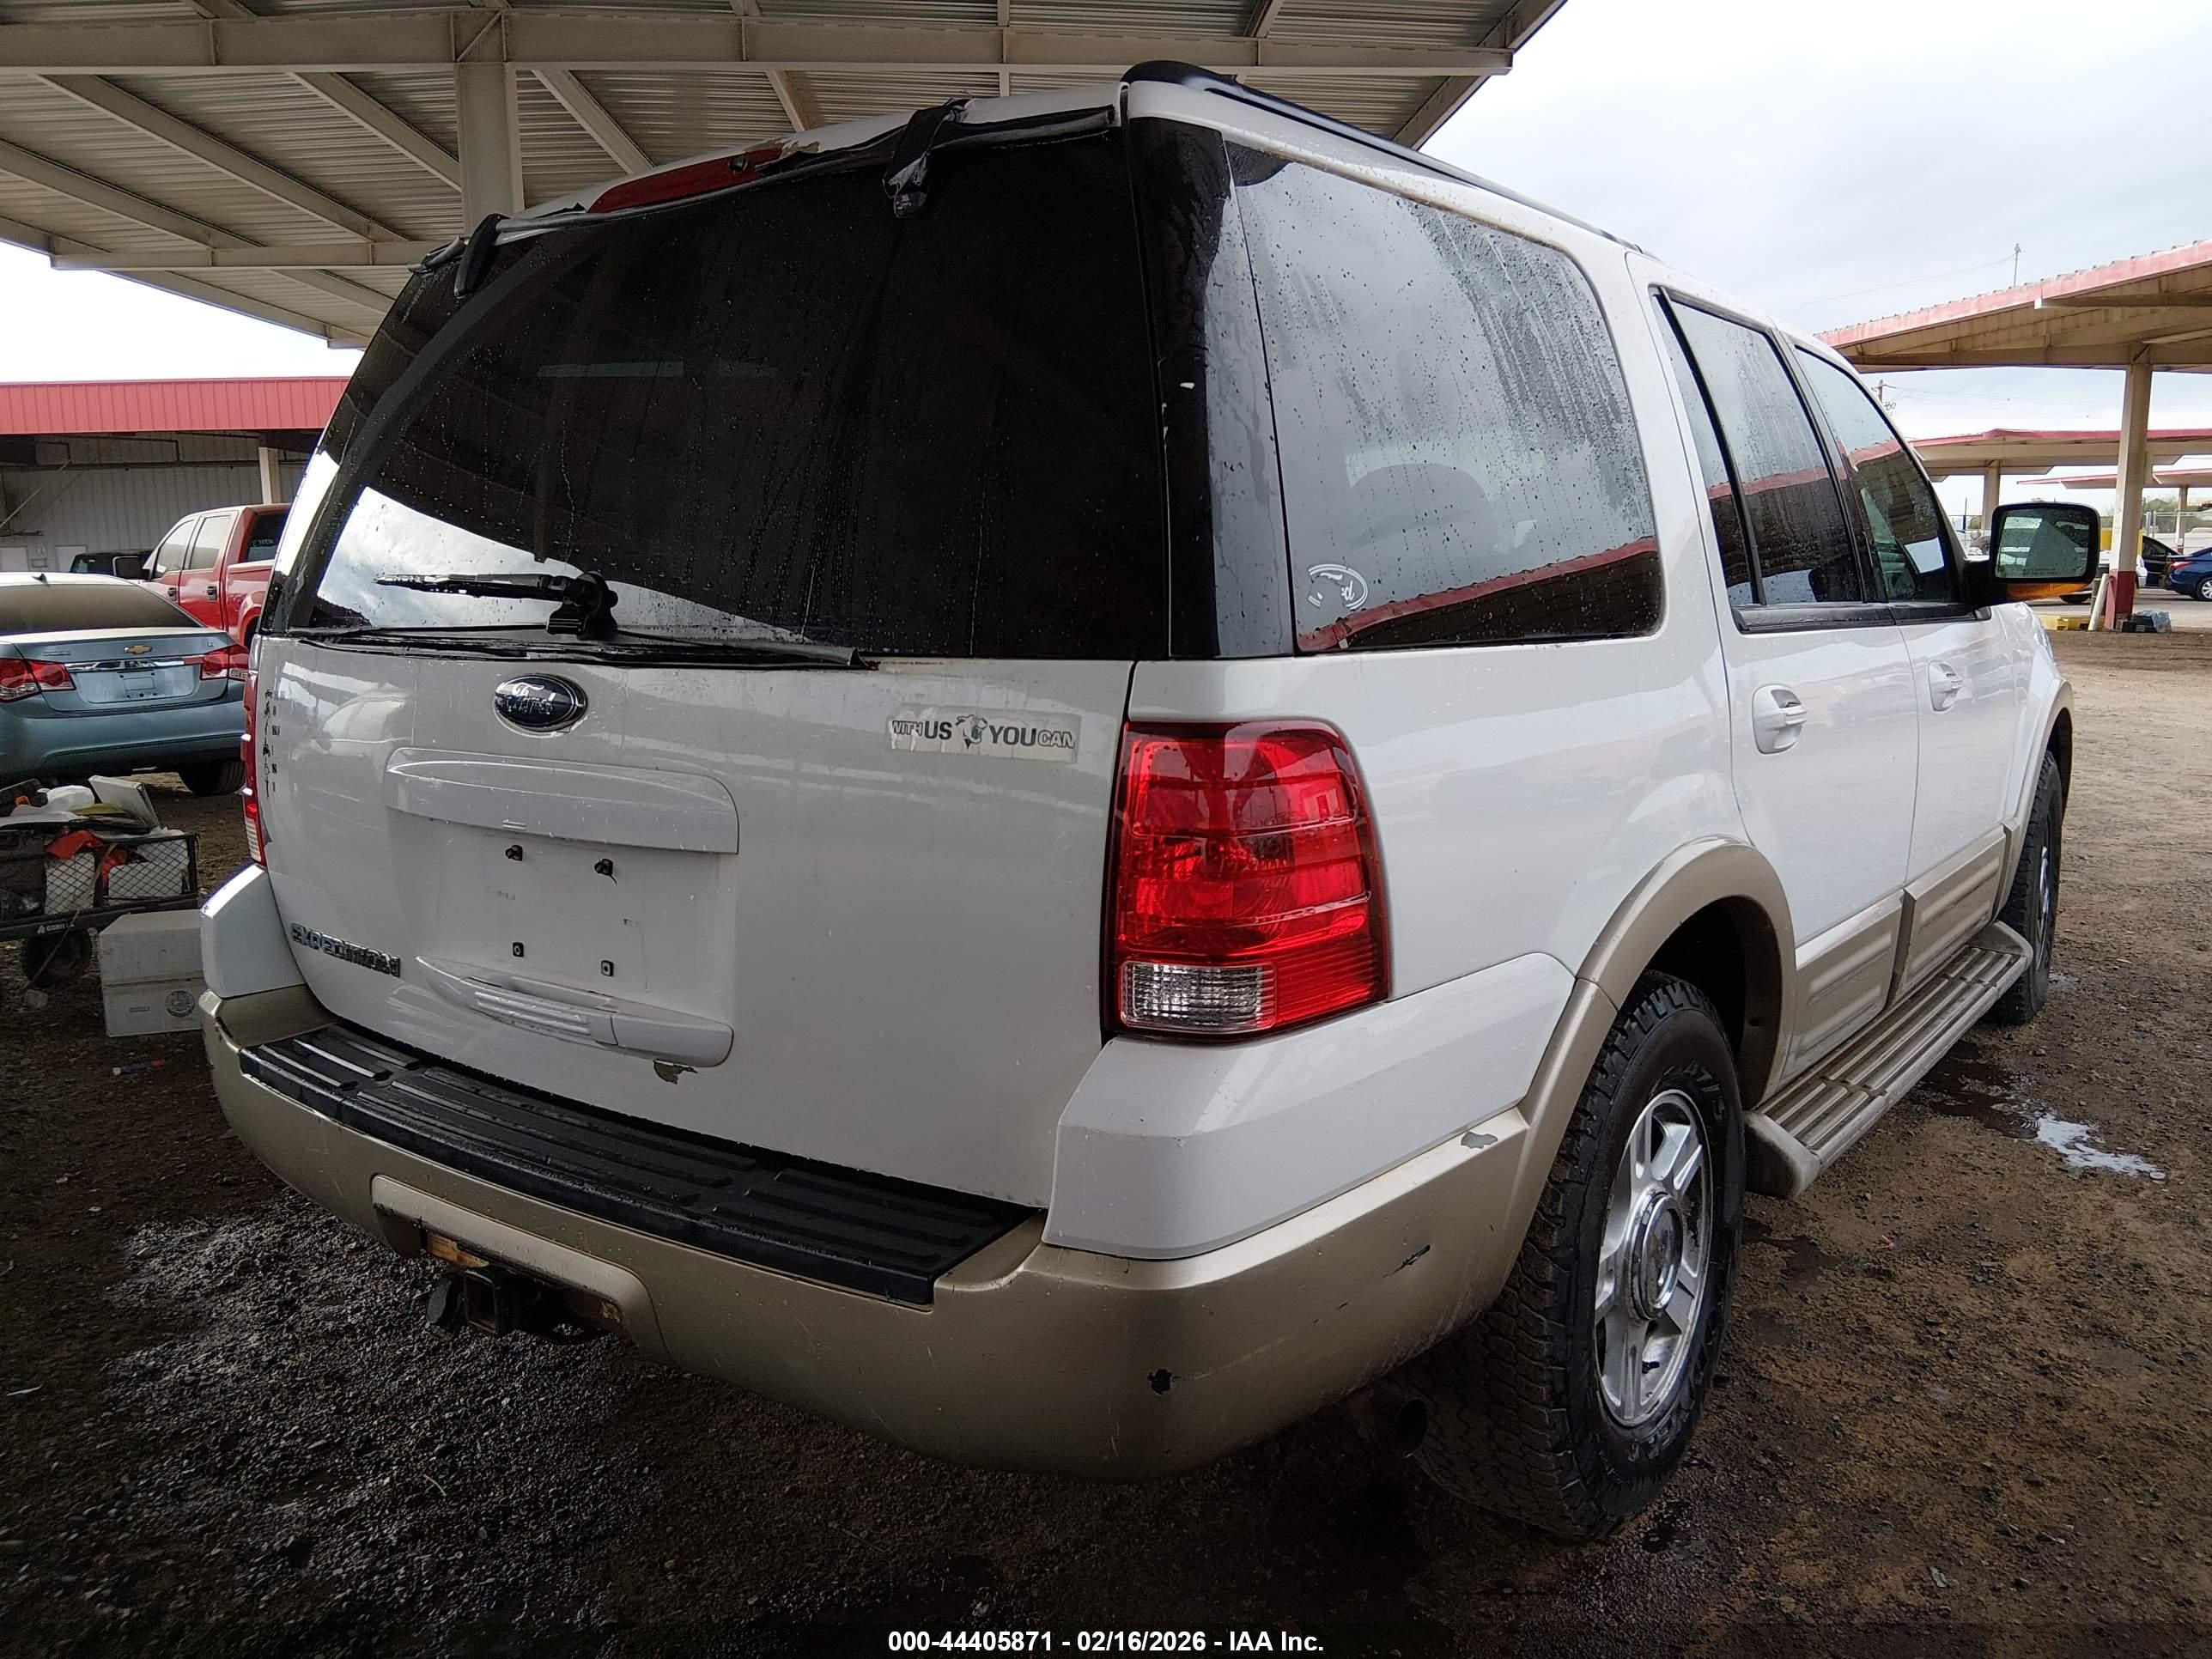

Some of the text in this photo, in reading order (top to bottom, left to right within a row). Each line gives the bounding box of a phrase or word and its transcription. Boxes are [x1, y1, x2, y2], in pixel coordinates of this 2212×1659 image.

[892, 720, 1076, 750] WITH US YOU CAN
